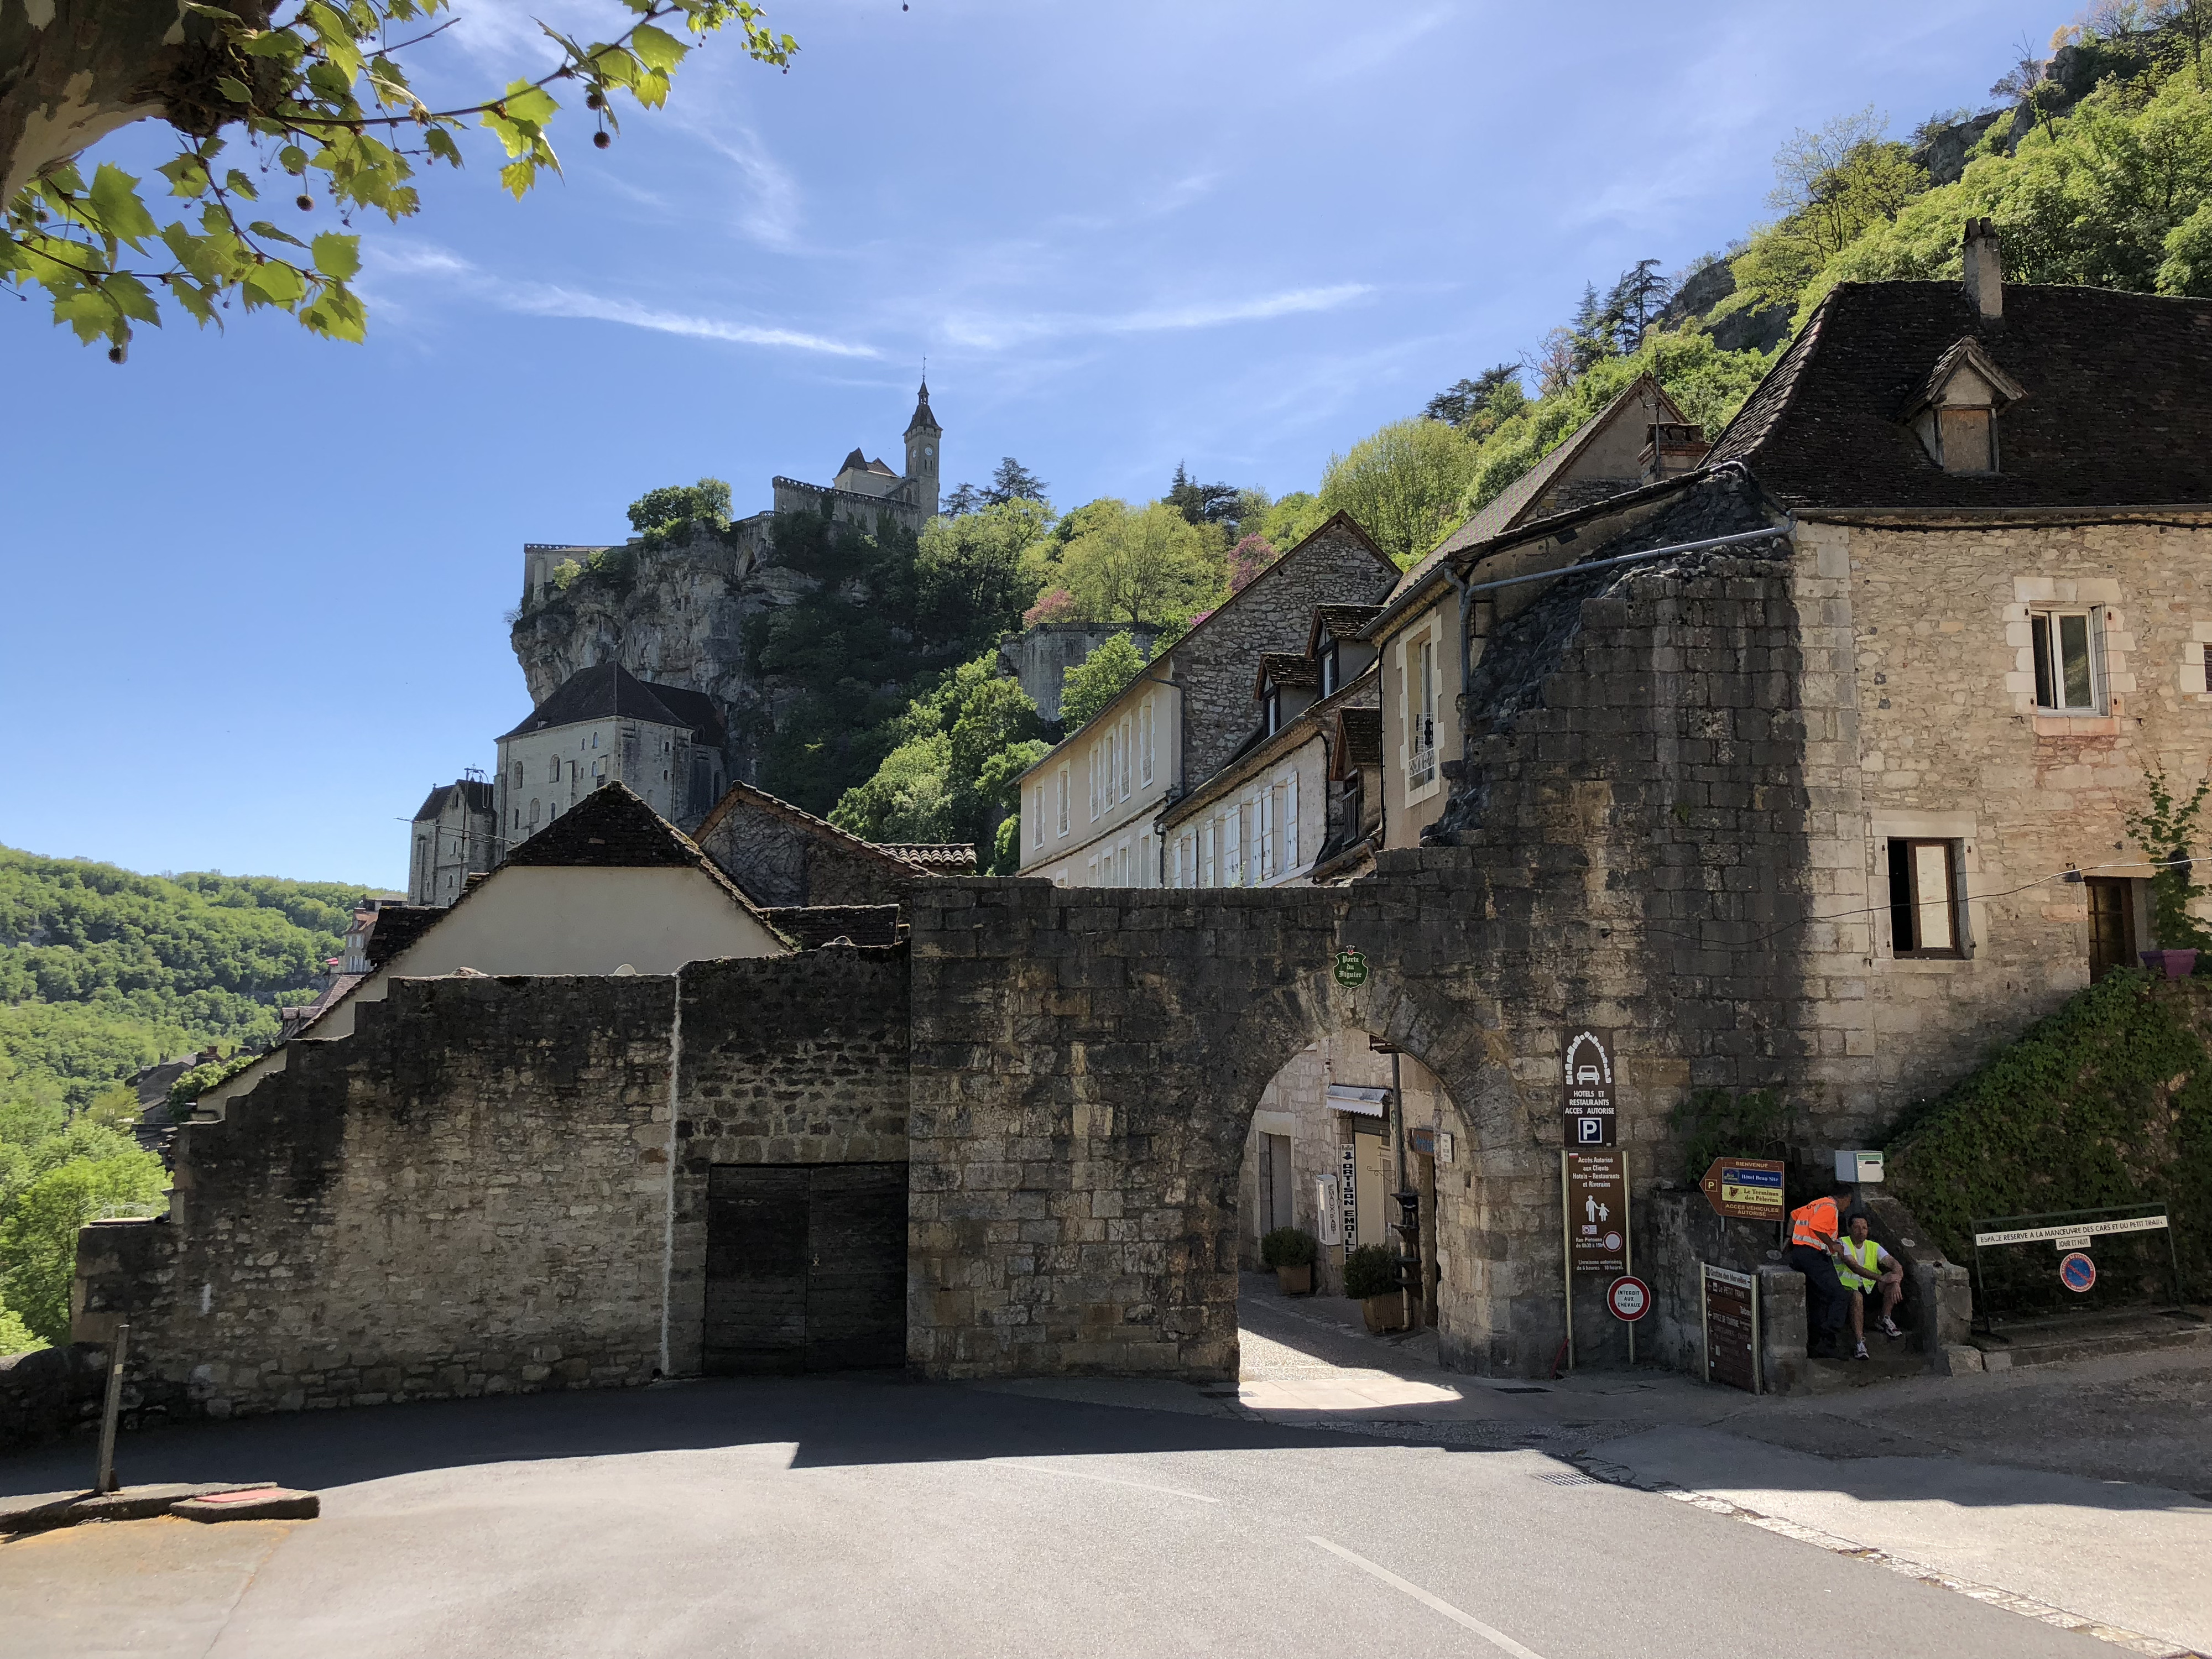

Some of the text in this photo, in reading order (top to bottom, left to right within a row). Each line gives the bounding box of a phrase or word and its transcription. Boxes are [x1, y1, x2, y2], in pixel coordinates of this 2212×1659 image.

[1342, 955, 1359, 963] Porte
[1338, 971, 1362, 979] Figuier
[1583, 1120, 1597, 1140] P
[1343, 1163, 1354, 1206] ARTISAN
[2004, 1232, 2028, 1241] RESERVE
[2044, 1227, 2081, 1237] MANŒUVRE
[1723, 1286, 1733, 1296] PETIT
[1735, 1288, 1745, 1299] TRAIN
